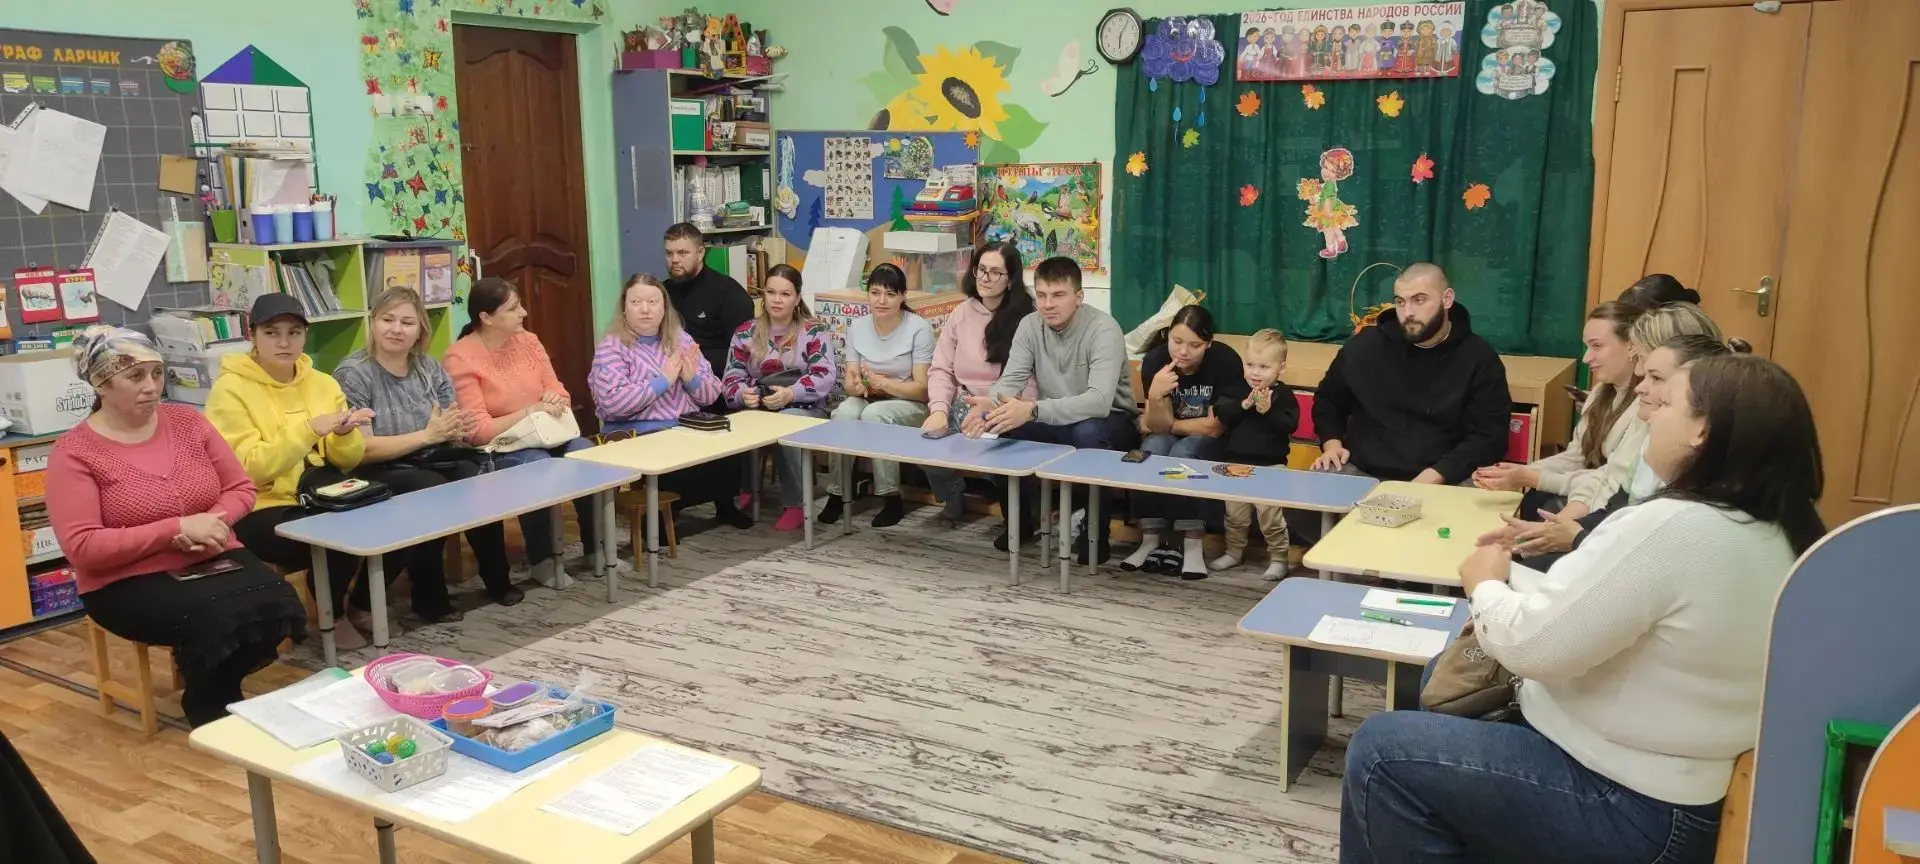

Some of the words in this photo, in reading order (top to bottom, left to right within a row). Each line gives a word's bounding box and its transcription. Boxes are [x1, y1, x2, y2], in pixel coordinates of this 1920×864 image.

[1298, 8, 1353, 21] ЕДИНСТВА
[1358, 5, 1410, 19] НАРОДОВ
[1414, 3, 1462, 17] РОССИИ
[0, 44, 42, 60] РАФ
[54, 47, 120, 64] ЛАРЧИК
[823, 302, 872, 317] АЛФАВ
